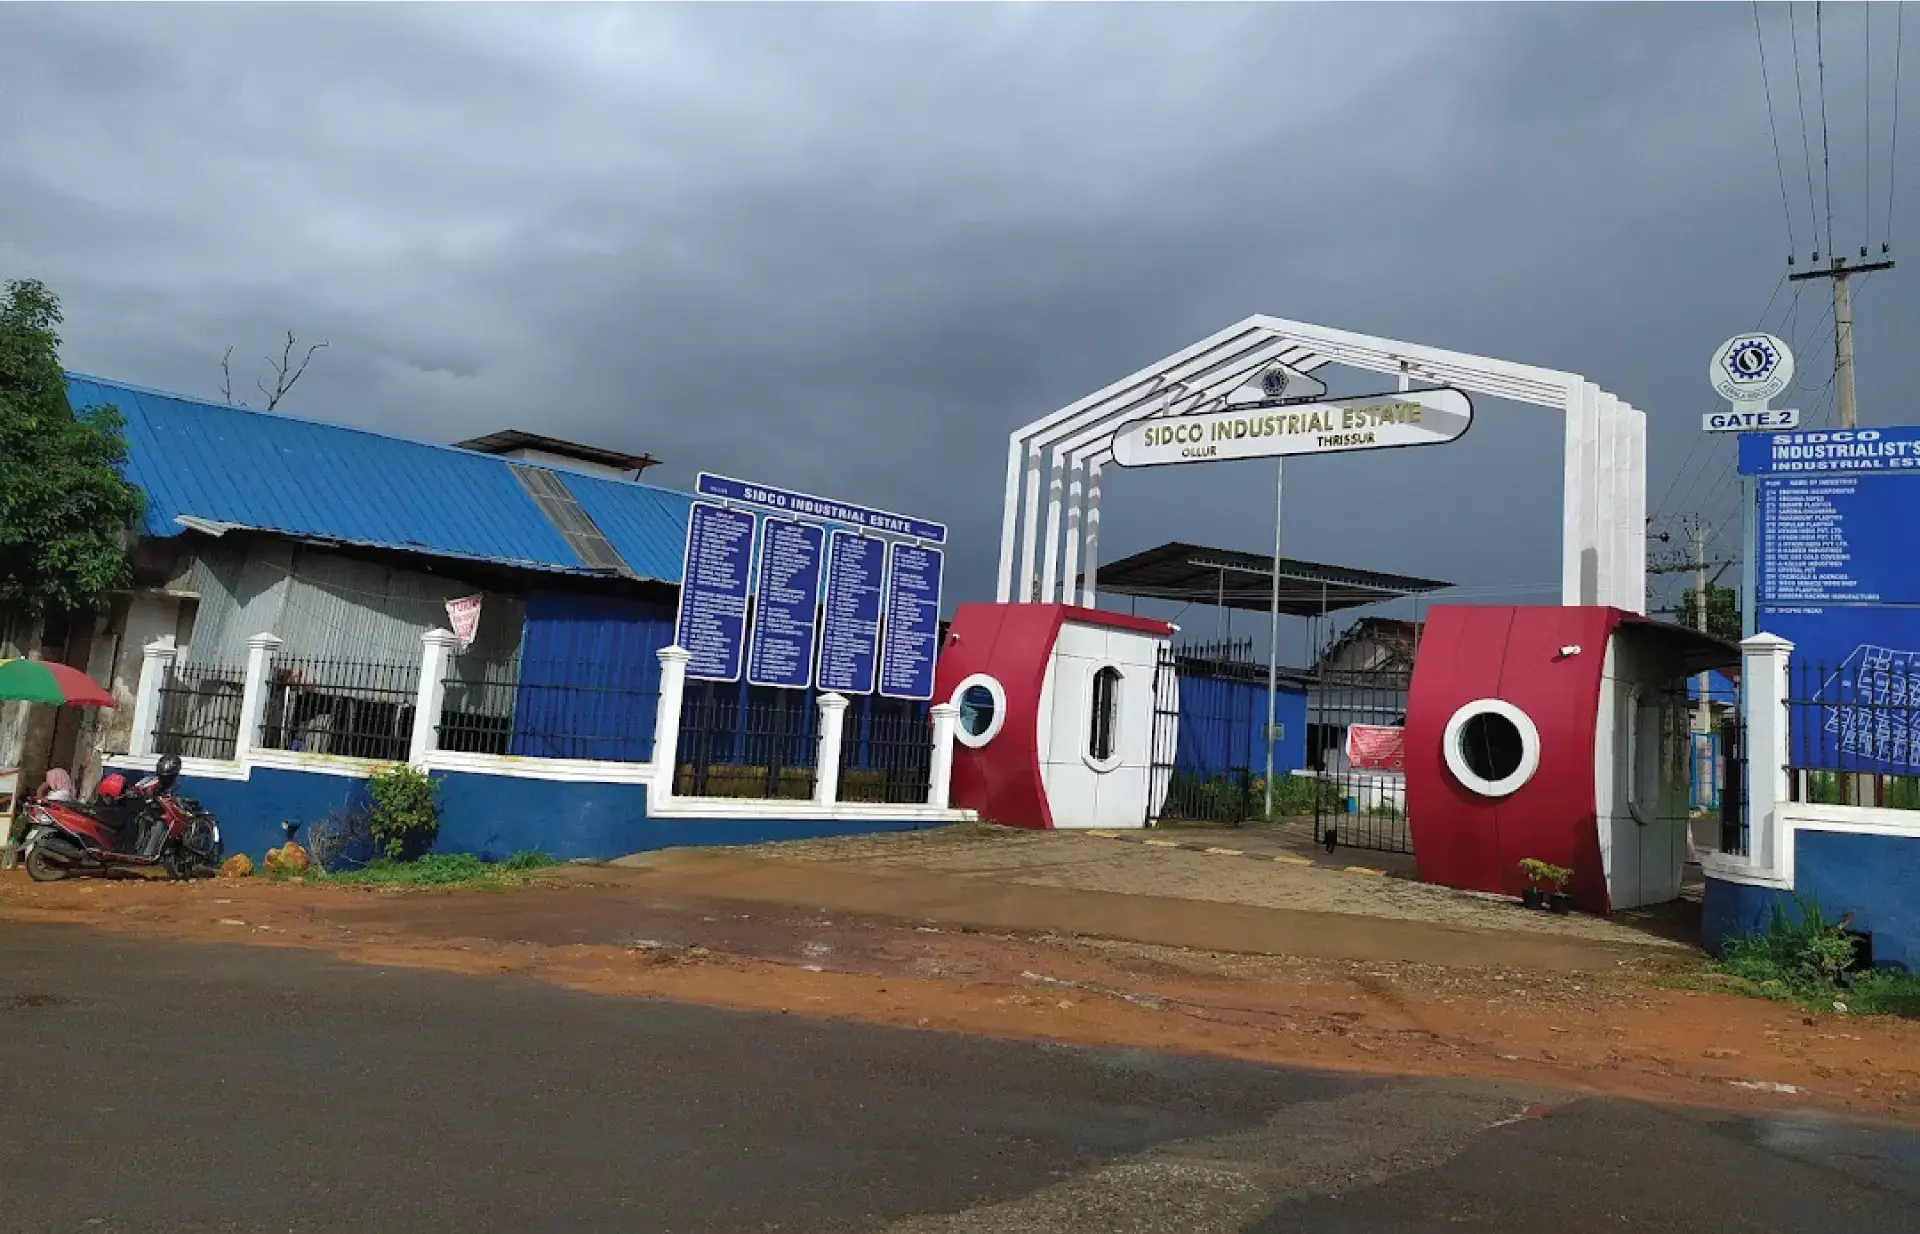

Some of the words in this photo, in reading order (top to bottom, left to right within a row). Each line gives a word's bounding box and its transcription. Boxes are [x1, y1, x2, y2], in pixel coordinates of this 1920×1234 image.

[1145, 422, 1203, 447] SIDCO
[1211, 409, 1333, 442] INDUSTRIAL
[1342, 401, 1421, 429] ESTATE
[1317, 432, 1375, 448] THRISSUR
[1772, 431, 1880, 445] SIDCO
[1181, 445, 1217, 458] OLLUR
[1772, 459, 1883, 470] INDUSTRIAL
[743, 488, 787, 507] SIDCO
[791, 498, 865, 523] INDUSTRIAL
[869, 515, 911, 532] ESTATE
